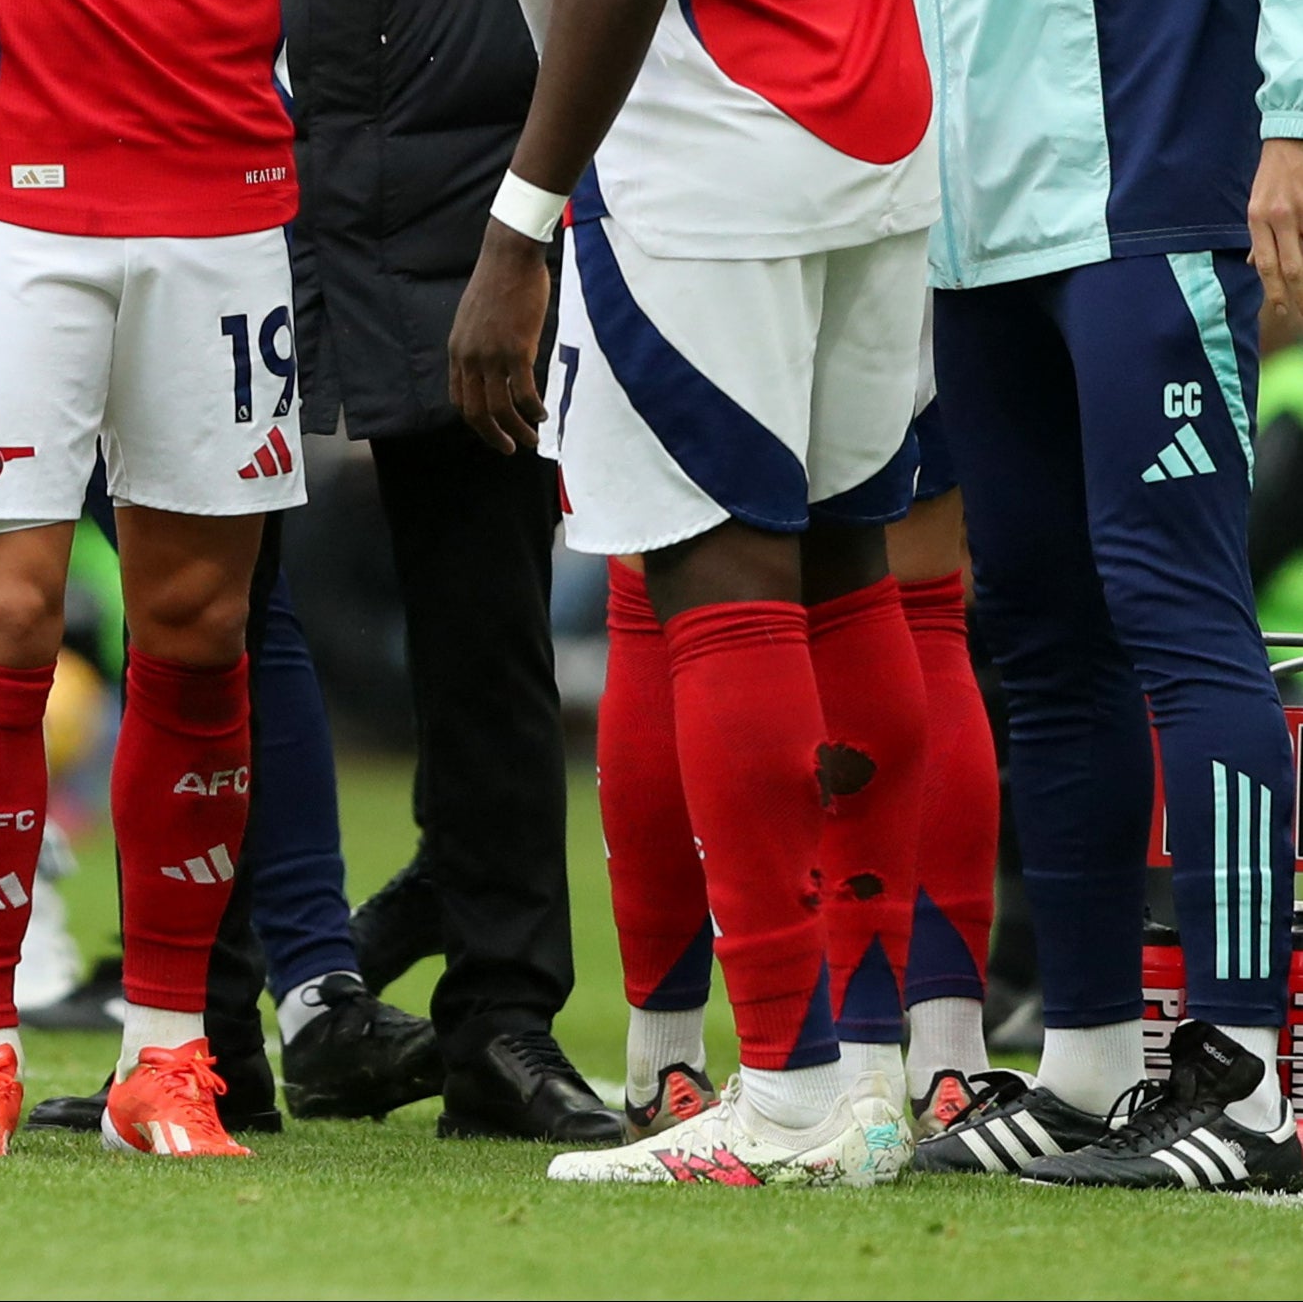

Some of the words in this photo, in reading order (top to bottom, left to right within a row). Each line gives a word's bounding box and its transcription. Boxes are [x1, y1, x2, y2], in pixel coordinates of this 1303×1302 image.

[220, 305, 297, 424] 19
[1164, 381, 1202, 418] CC
[173, 765, 250, 796] AFC
